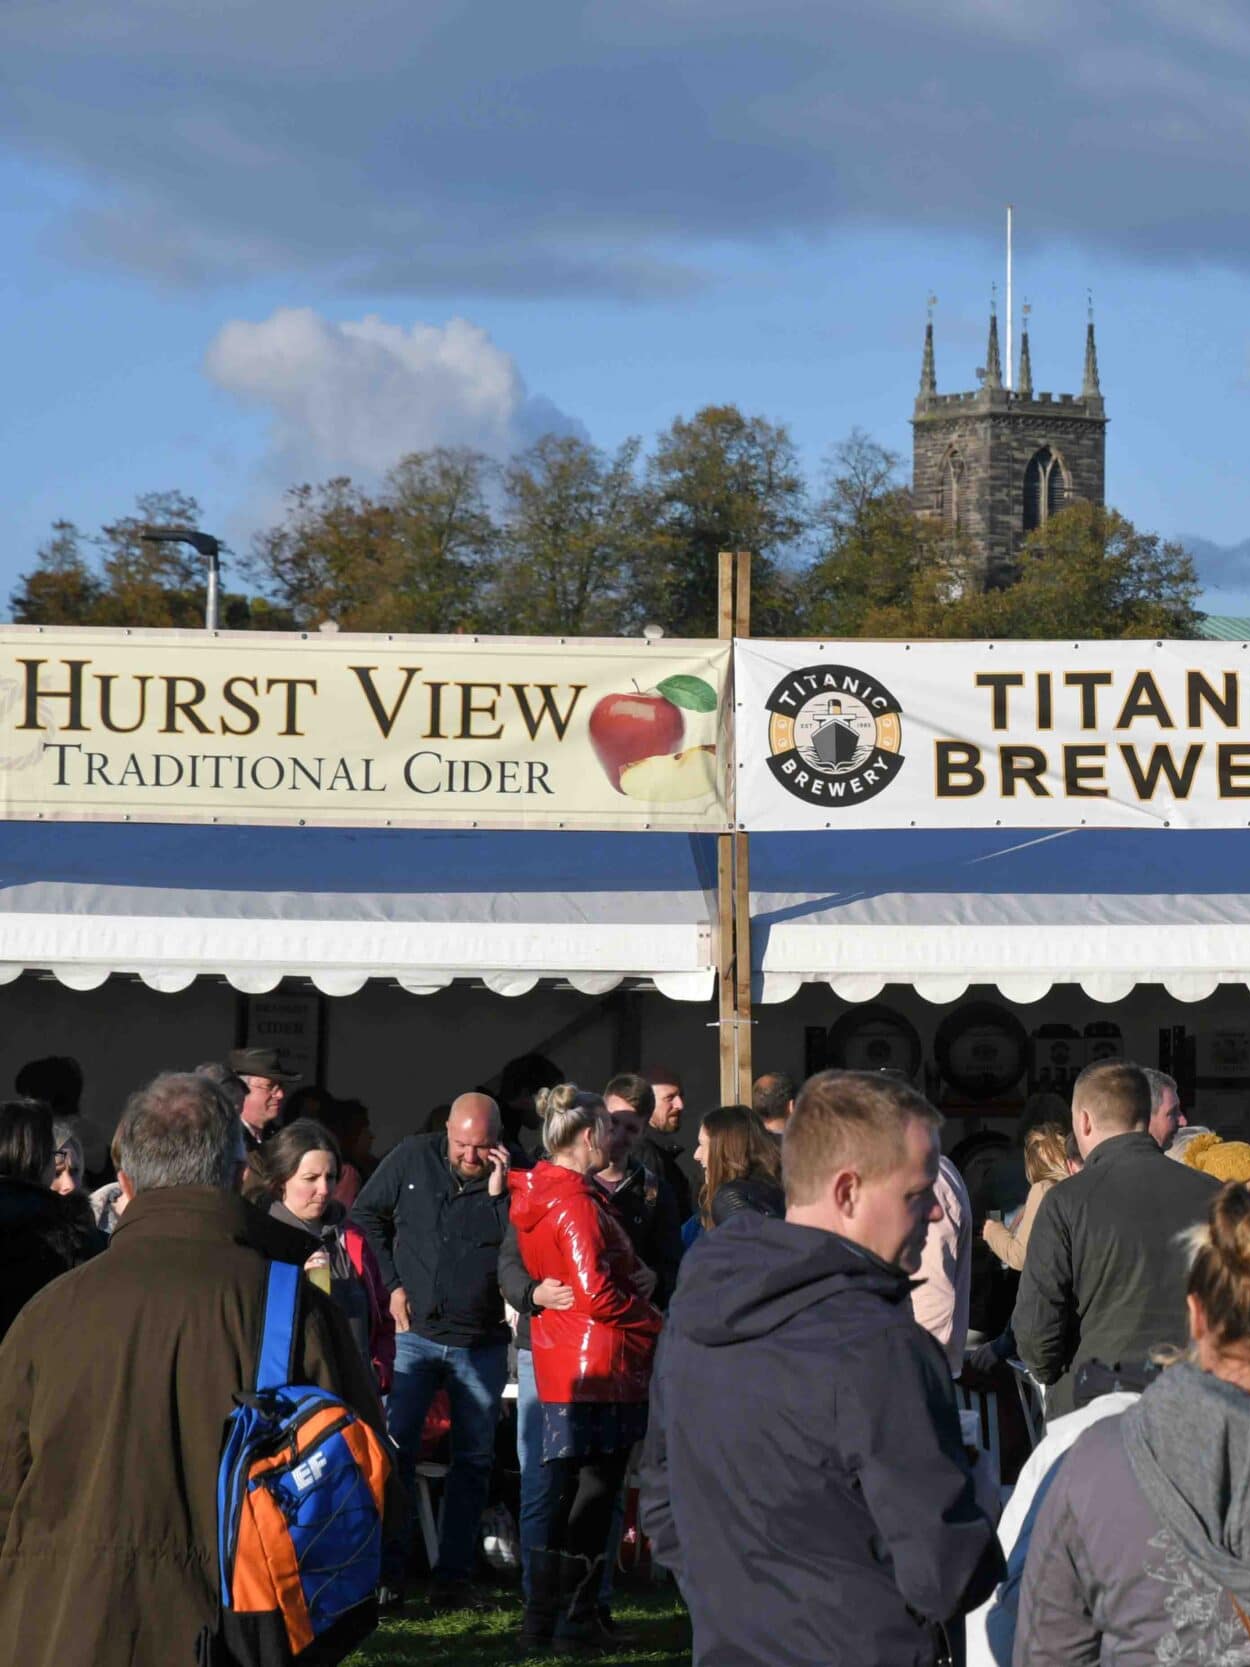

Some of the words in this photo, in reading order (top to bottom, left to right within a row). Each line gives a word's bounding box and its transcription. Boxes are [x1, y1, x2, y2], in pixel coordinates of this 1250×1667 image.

[15, 658, 318, 737] HURST
[347, 666, 588, 741] VIEW
[778, 673, 888, 709] TITANIC
[43, 742, 387, 794] TRADITIONAL
[403, 751, 556, 796] CIDER
[781, 756, 888, 797] BREWERY
[291, 1451, 327, 1490] EF
